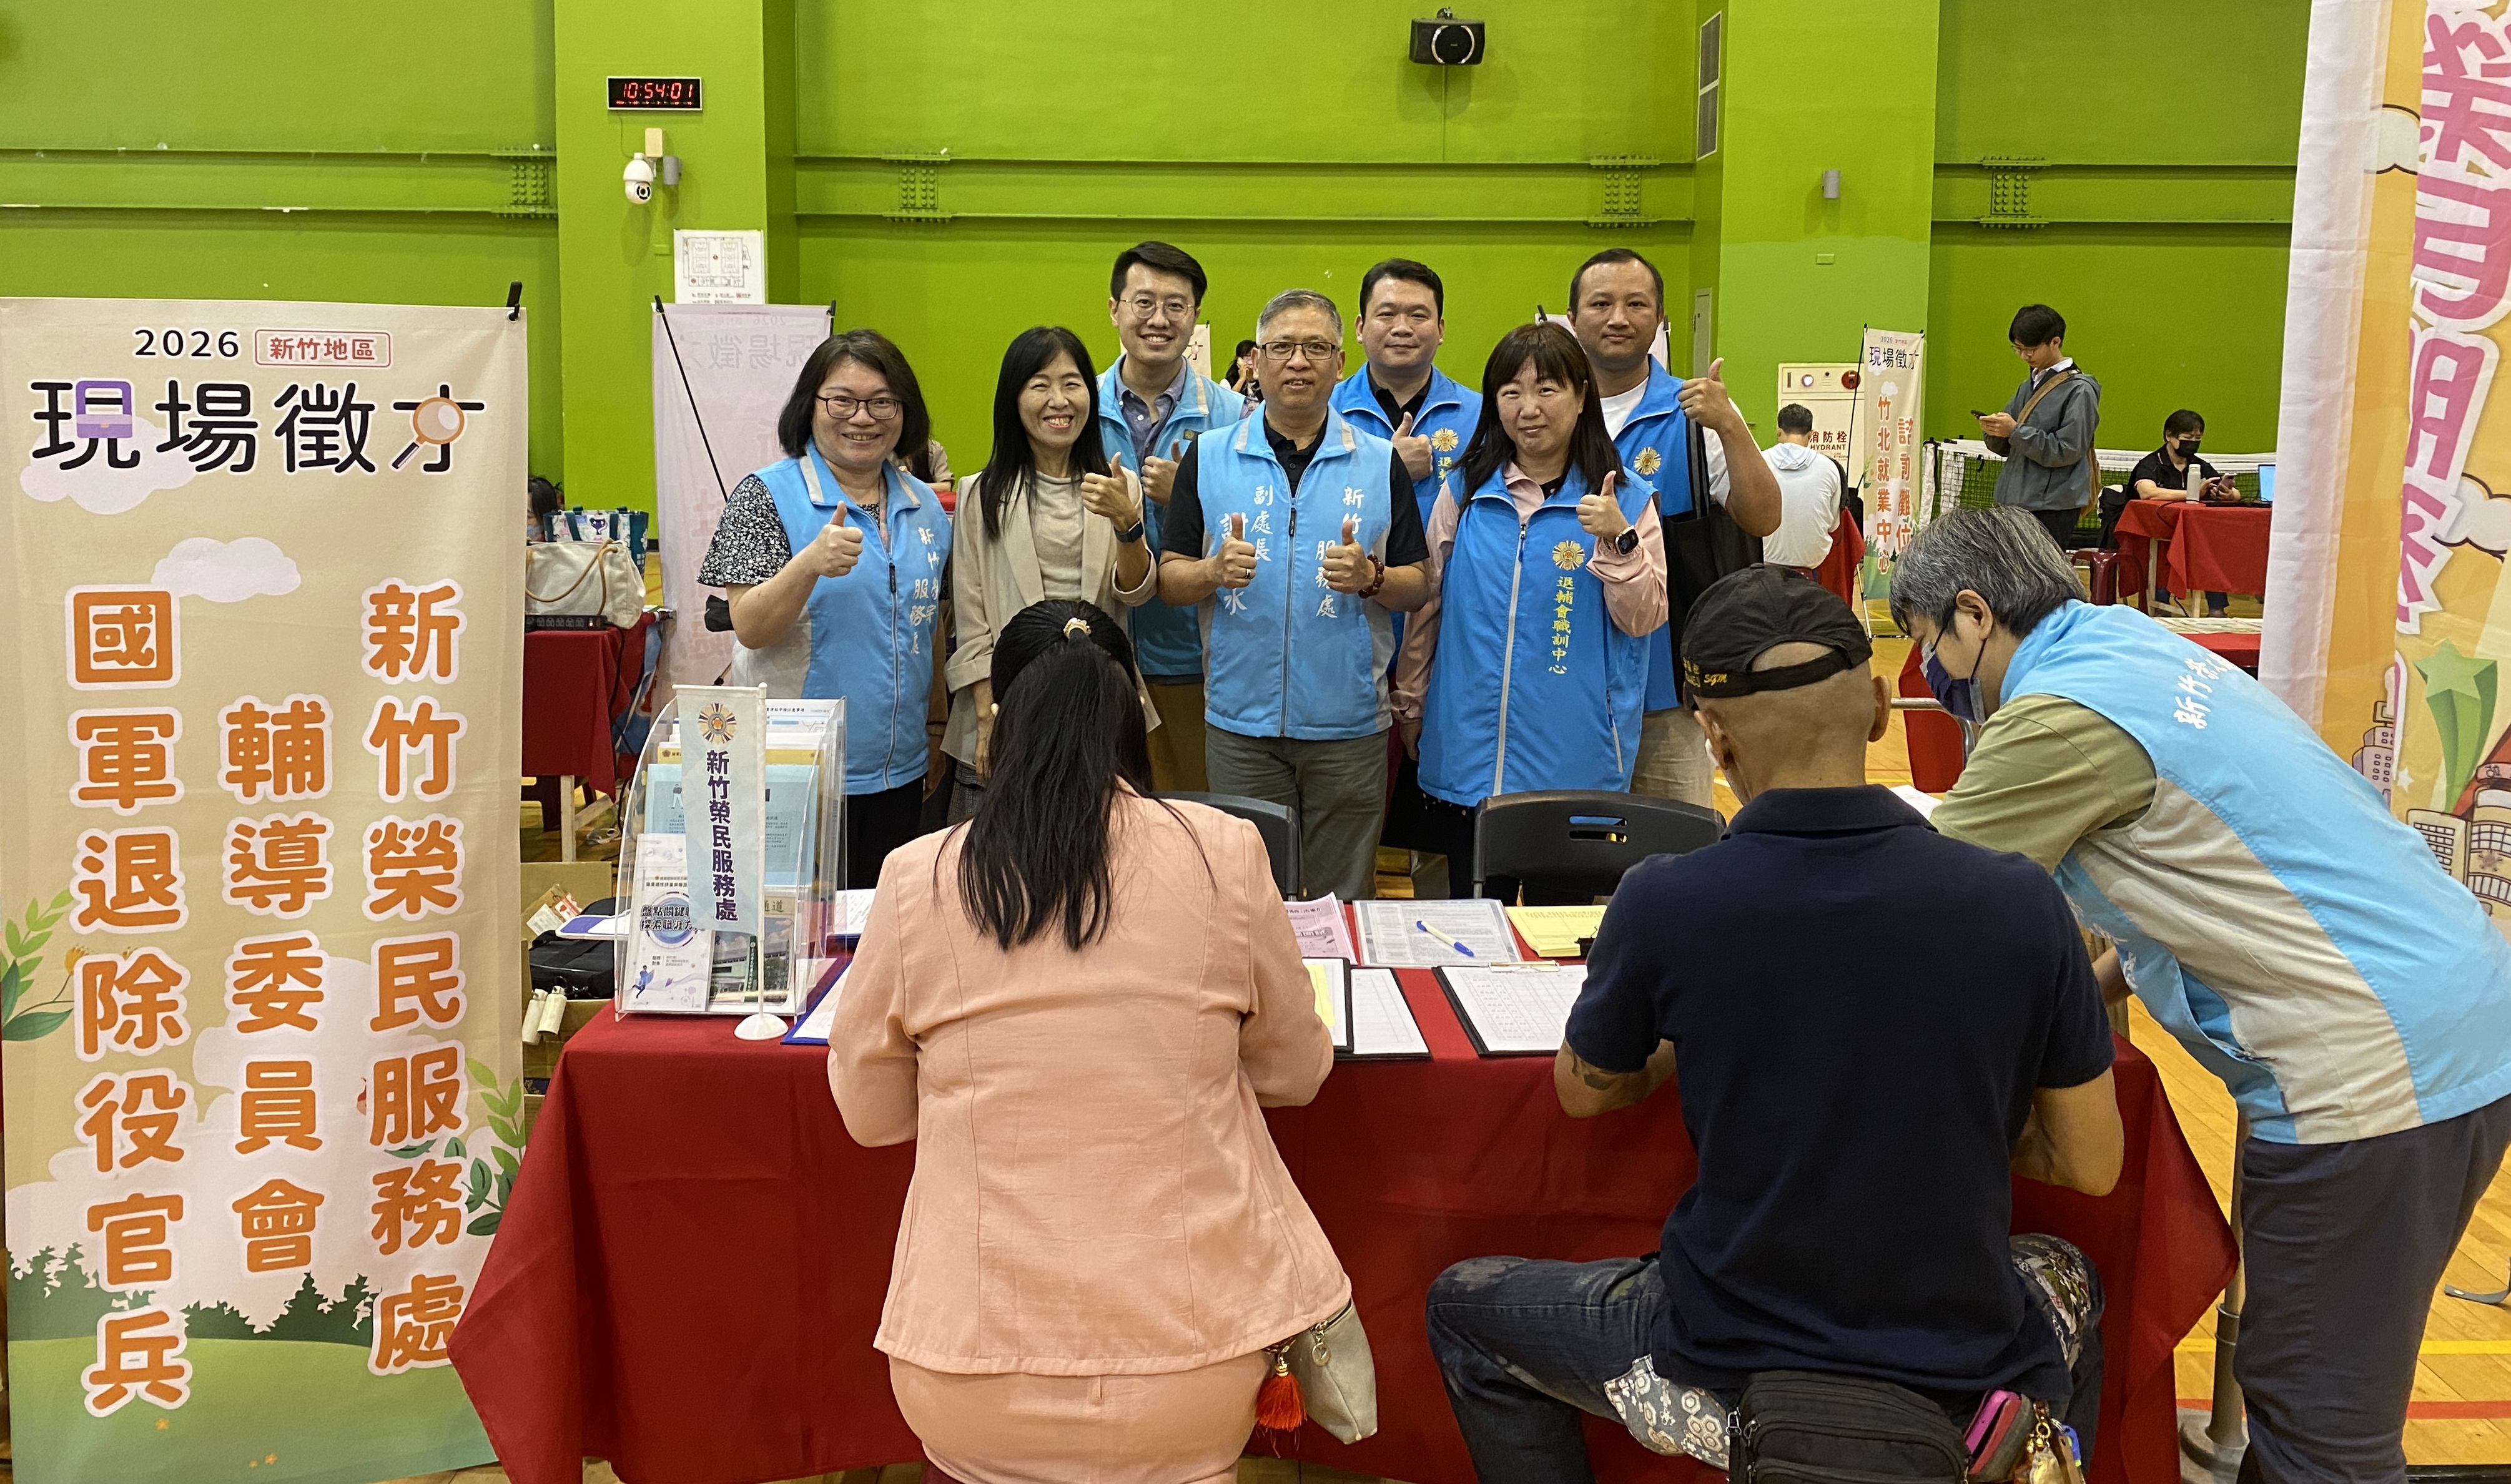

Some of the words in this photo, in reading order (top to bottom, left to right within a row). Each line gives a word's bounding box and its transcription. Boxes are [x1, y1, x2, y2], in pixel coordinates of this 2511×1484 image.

[623, 82, 693, 99] 10:54:01
[134, 329, 240, 358] 2026
[270, 337, 376, 361] 新竹地區
[1868, 346, 1919, 370] 現場徵才
[31, 380, 485, 474] 現場徵才
[1810, 431, 1847, 443] 消防栓
[1877, 396, 1892, 573] 竹北就業中心
[1219, 513, 1249, 616] 謝水
[1548, 576, 1576, 675] 退輔會職訓中心
[706, 749, 739, 922] 新竹榮民服務處
[641, 920, 698, 930] 探索職涯方
[73, 590, 187, 1410] 國軍退除役官兵
[224, 699, 327, 1274] 輔導委員會
[368, 584, 465, 1370] 新竹榮民服務處
